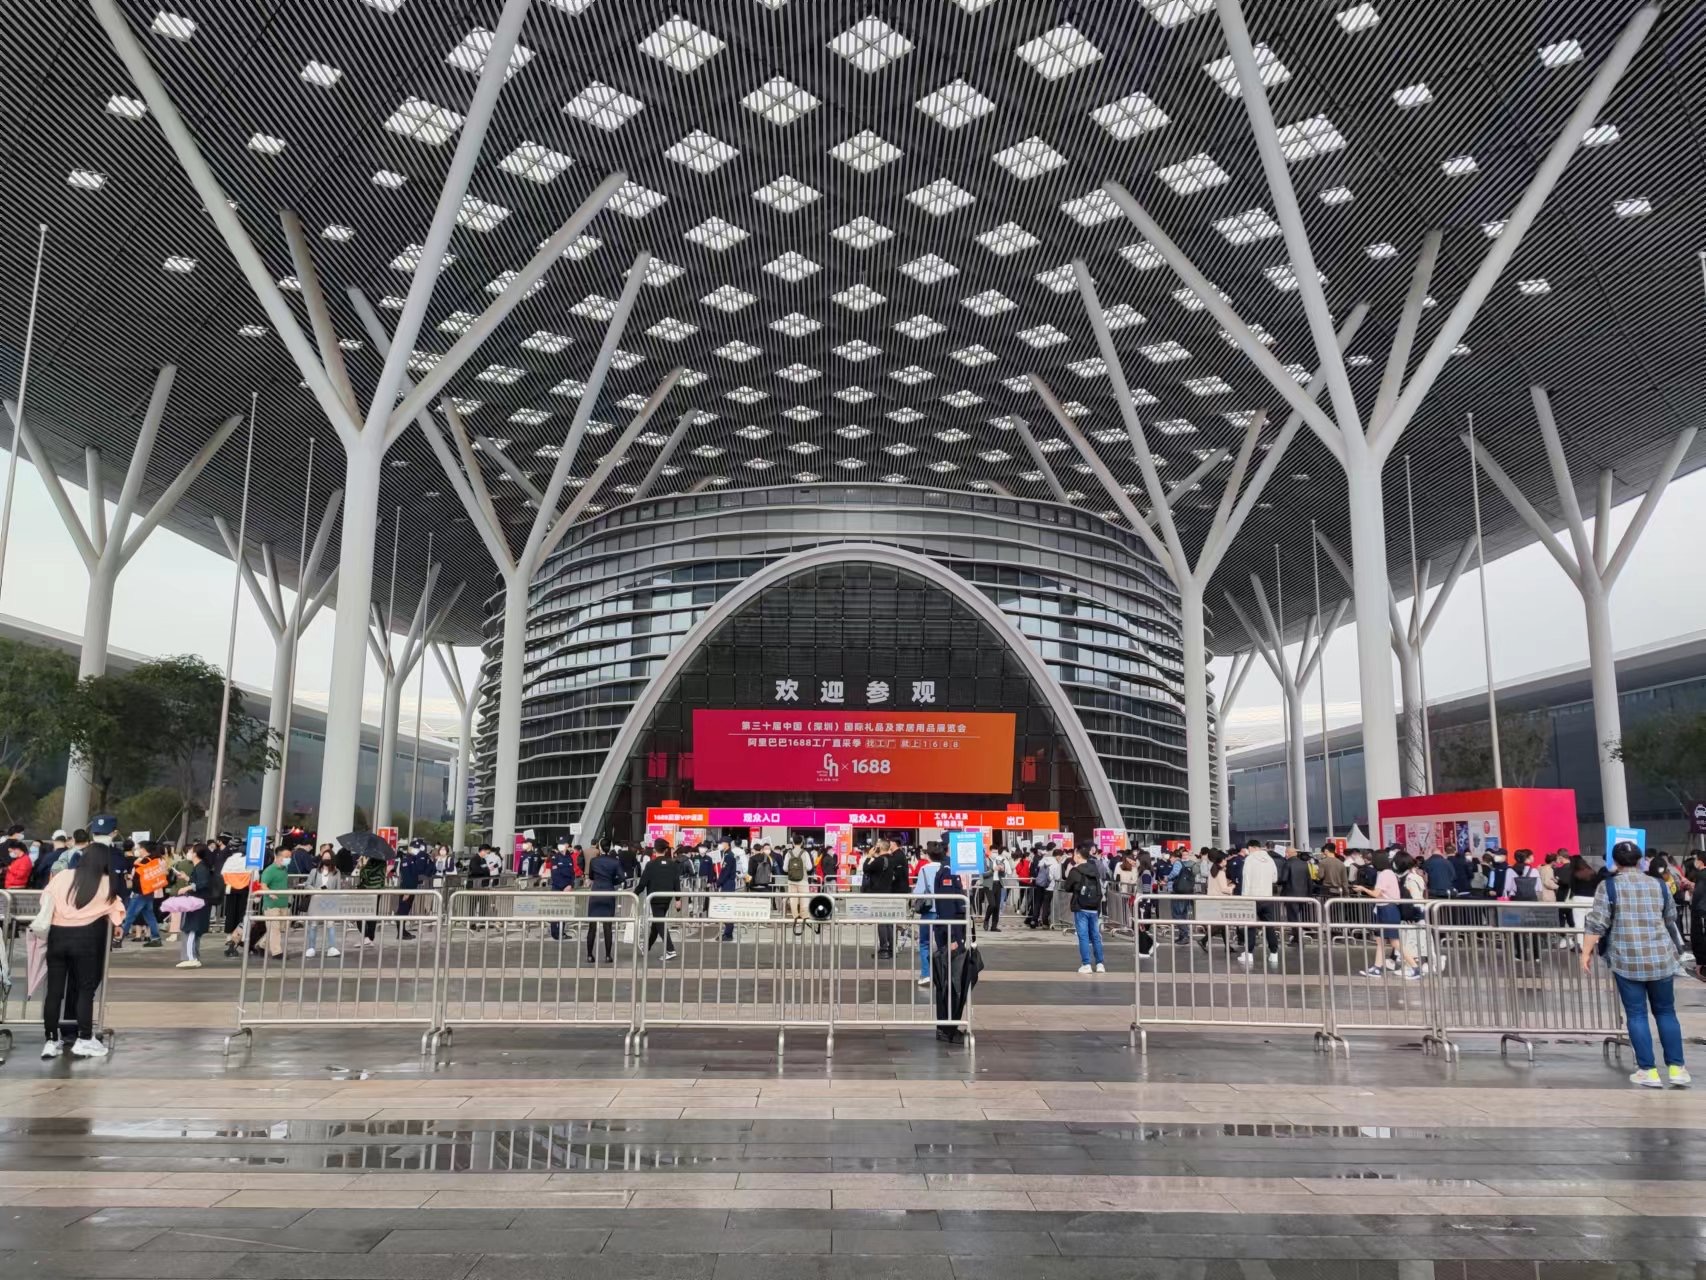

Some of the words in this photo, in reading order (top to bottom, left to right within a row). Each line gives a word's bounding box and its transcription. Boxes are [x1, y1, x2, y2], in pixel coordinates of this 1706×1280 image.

[775, 678, 936, 704] 欢迎参观
[851, 759, 891, 774] 1688
[743, 812, 780, 823] 观众入口
[848, 813, 886, 824] 观众入口
[1006, 815, 1026, 826] 出口
